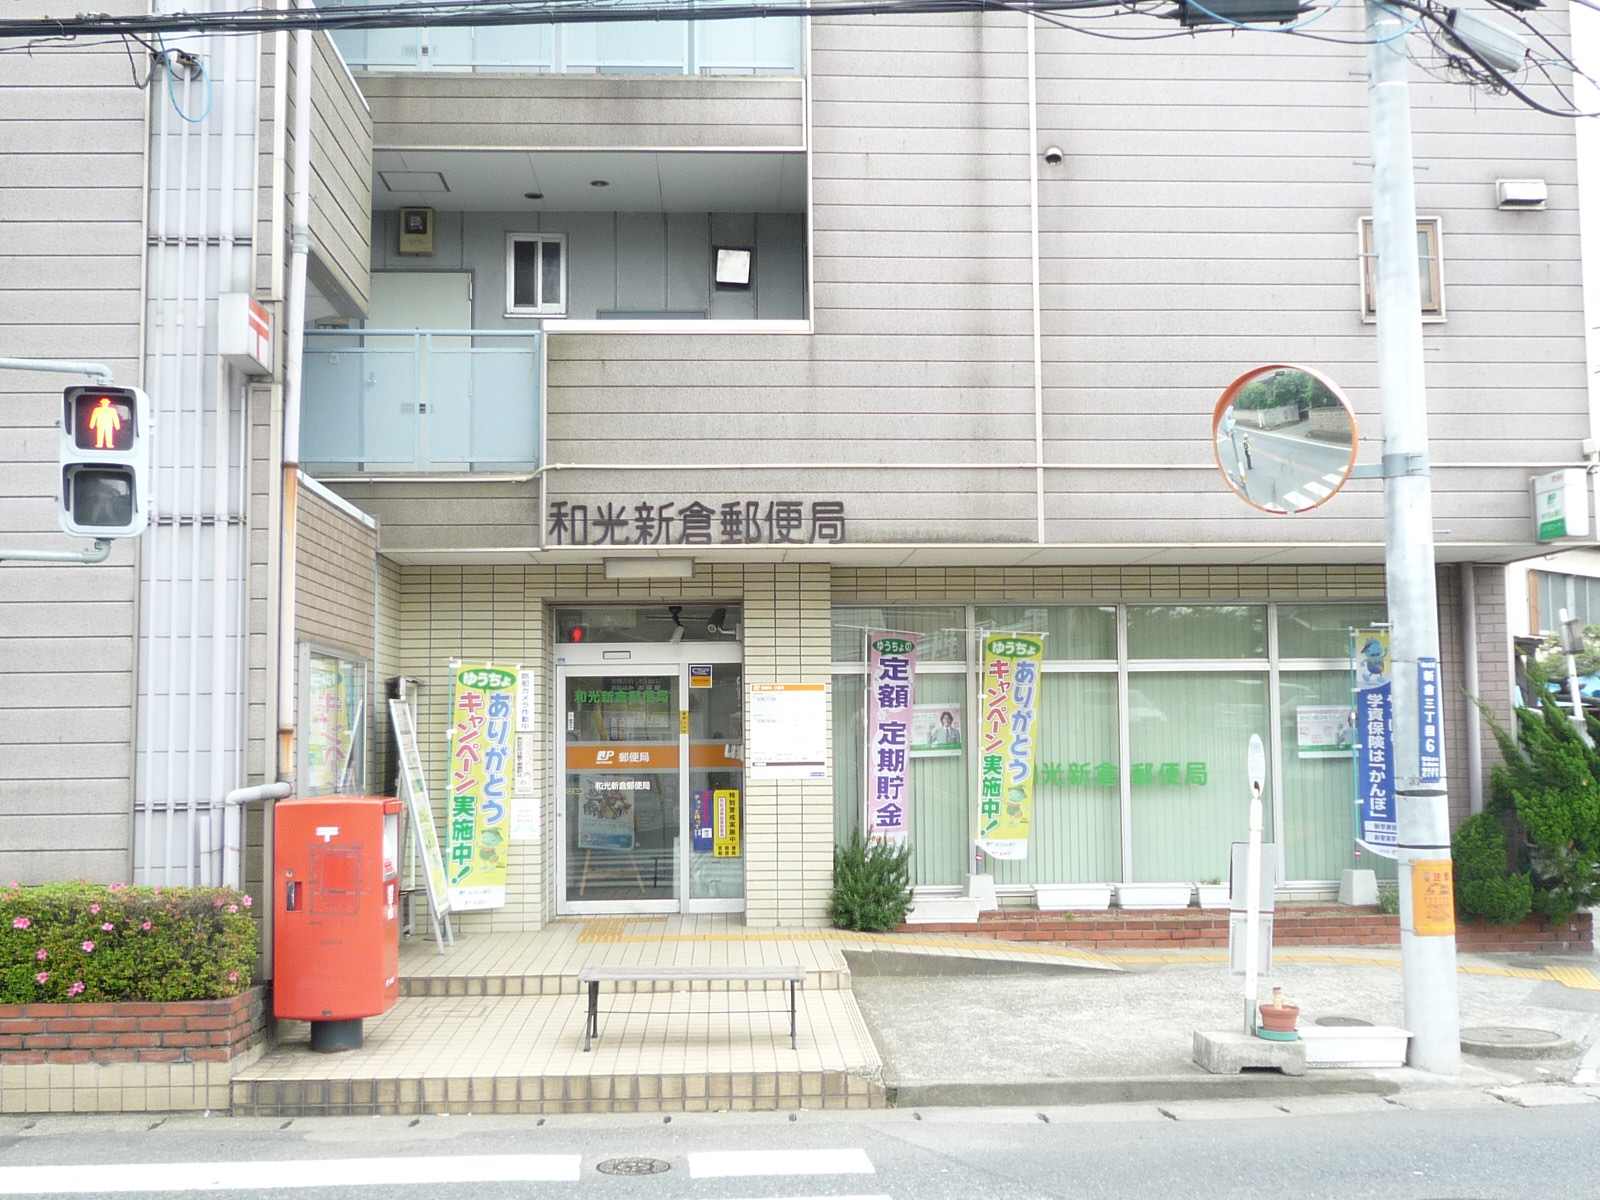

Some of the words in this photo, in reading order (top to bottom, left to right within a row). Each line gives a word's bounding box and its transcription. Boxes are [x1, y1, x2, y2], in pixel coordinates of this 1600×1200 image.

[549, 501, 845, 545] 和光新倉郵便局
[875, 638, 912, 651] ゆうちょの
[991, 642, 1036, 656] ゆうちょ
[462, 672, 512, 688] ゆうちょ
[521, 672, 530, 730] 防犯カメラ作動中
[575, 689, 669, 703] 和光新倉郵便局
[878, 657, 909, 709] 定額
[1008, 661, 1034, 782] ありがとう
[481, 692, 511, 826] ありがとう
[618, 752, 650, 763] 郵便局
[876, 722, 906, 827] 定期貯金
[1366, 693, 1387, 818] 学資保険は「かんぽ」
[595, 781, 651, 790] 和光新倉郵便局
